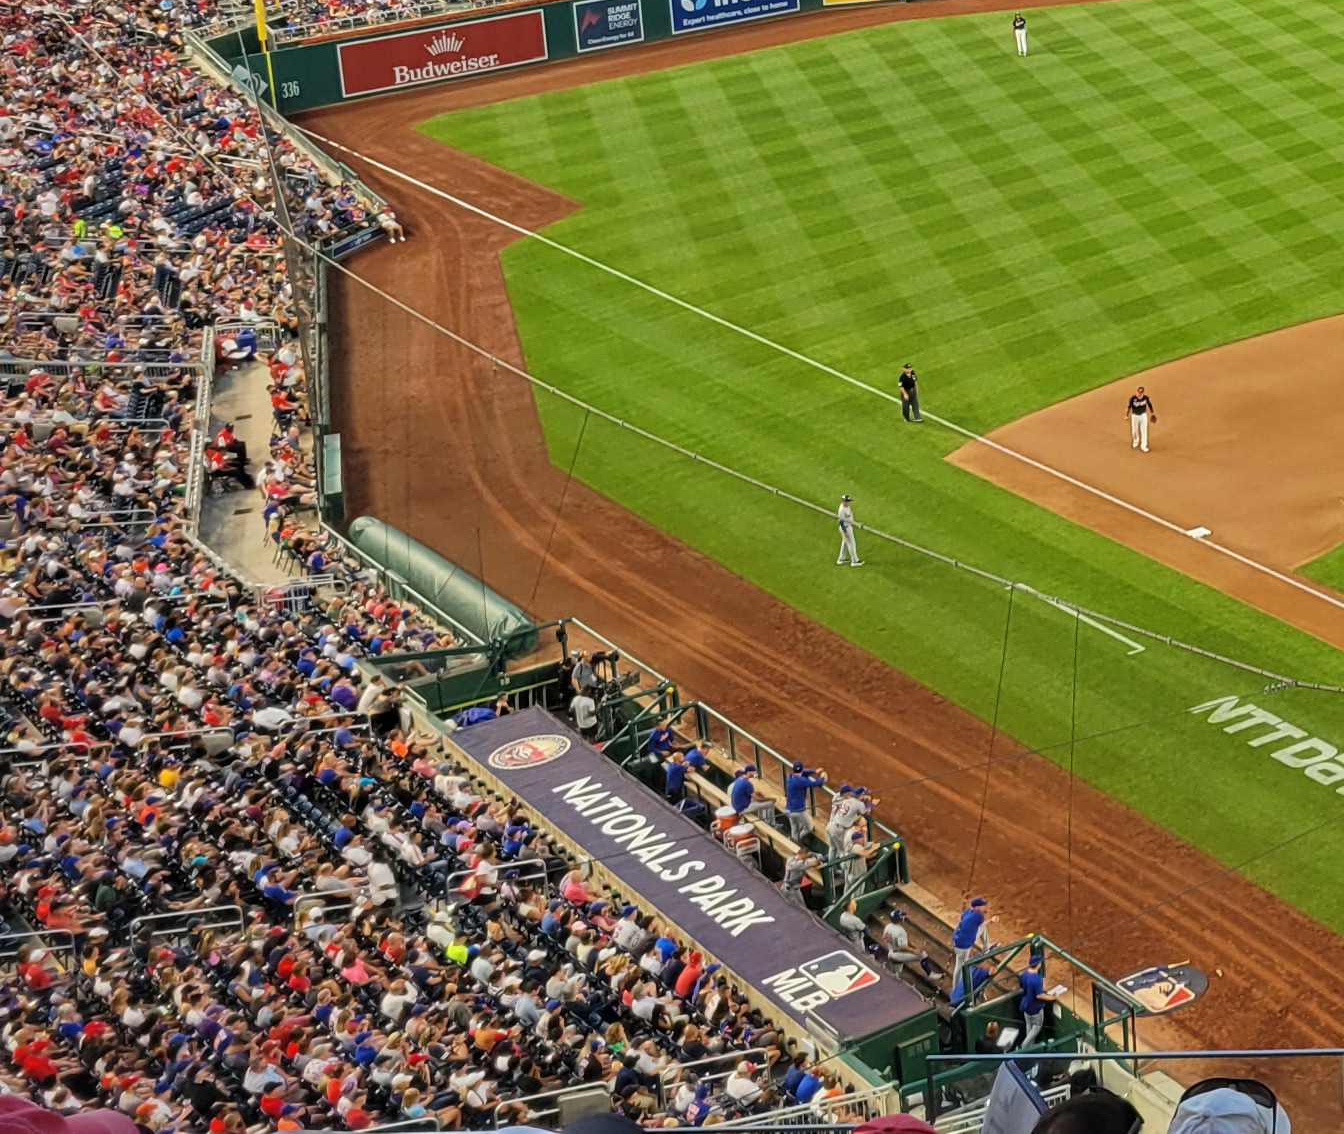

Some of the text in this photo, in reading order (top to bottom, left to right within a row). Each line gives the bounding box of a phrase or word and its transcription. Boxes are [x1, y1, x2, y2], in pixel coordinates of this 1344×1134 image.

[607, 3, 638, 15] SUMMIT
[608, 12, 631, 23] RIDGE
[608, 18, 638, 30] ENERGY
[393, 53, 498, 84] Budweiser
[281, 81, 300, 99] 336
[552, 776, 776, 938] NATIONALS PARK
[761, 967, 831, 1013] MLB
